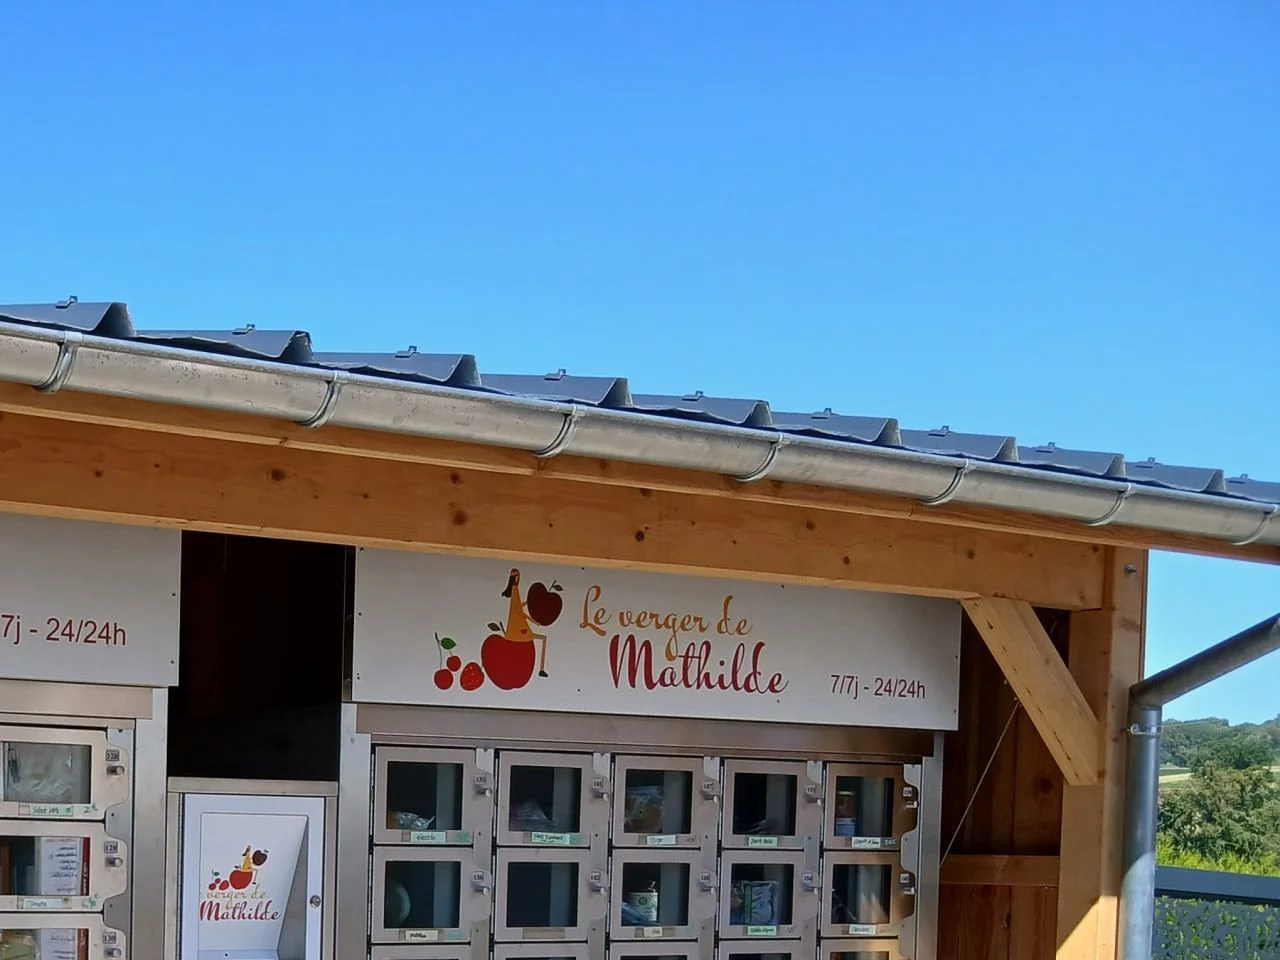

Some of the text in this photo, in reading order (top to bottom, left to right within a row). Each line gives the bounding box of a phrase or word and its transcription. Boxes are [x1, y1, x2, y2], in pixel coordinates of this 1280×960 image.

[46, 616, 128, 647] 24/24h
[579, 585, 753, 661] Le verger de
[609, 633, 789, 695] Mathilde
[830, 673, 860, 700] 7/7j
[874, 677, 926, 700] 24/24h
[104, 844, 118, 853] 129
[250, 883, 267, 900] de
[200, 900, 282, 921] Mathilde
